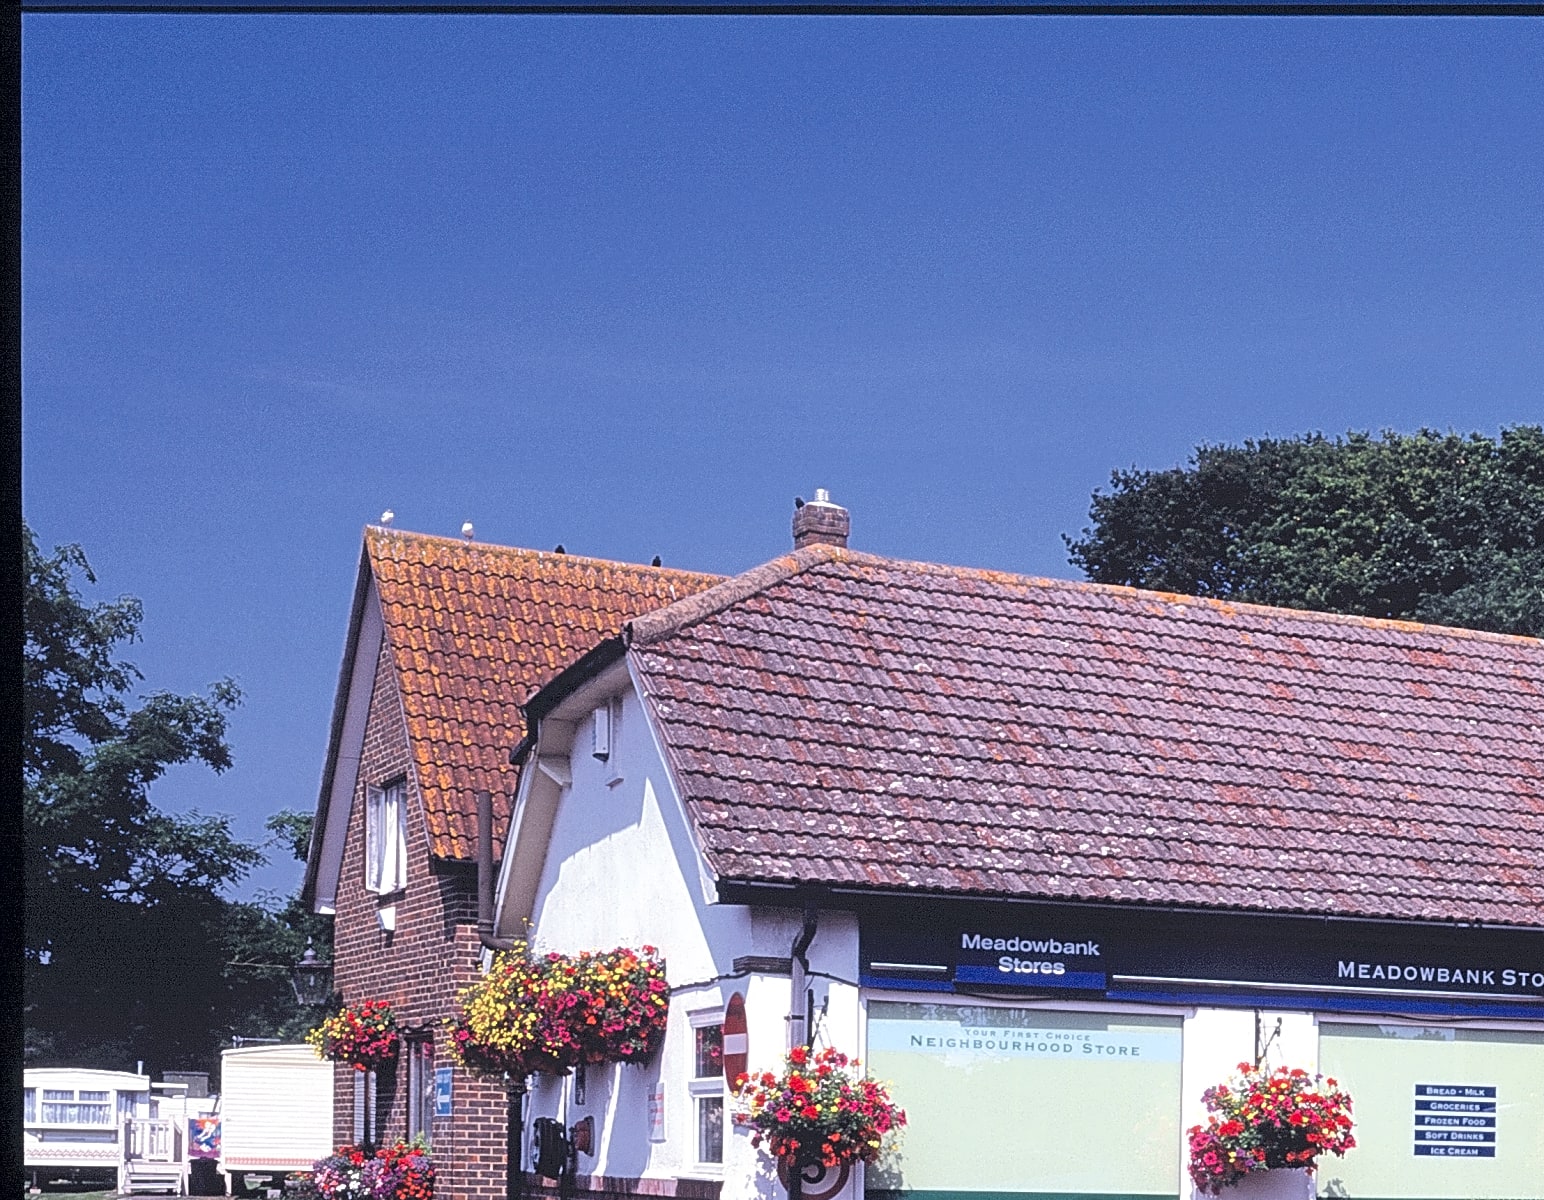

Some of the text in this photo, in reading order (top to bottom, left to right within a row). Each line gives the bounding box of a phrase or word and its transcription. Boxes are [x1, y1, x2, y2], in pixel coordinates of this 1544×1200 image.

[962, 933, 1100, 956] Meadowbank
[998, 956, 1066, 975] Stores
[1337, 960, 1495, 985] MEADOWBANK
[965, 1028, 1091, 1041] YOUR FIRST CHOICE
[910, 1035, 1141, 1057] NEIGHBOURHOOD STORE
[1430, 1102, 1481, 1111] GROCERIES
[1424, 1117, 1486, 1126] FROZEN FOOD
[1425, 1131, 1484, 1141] SOFT DRINKS
[1430, 1147, 1479, 1156] ICE CREAM
